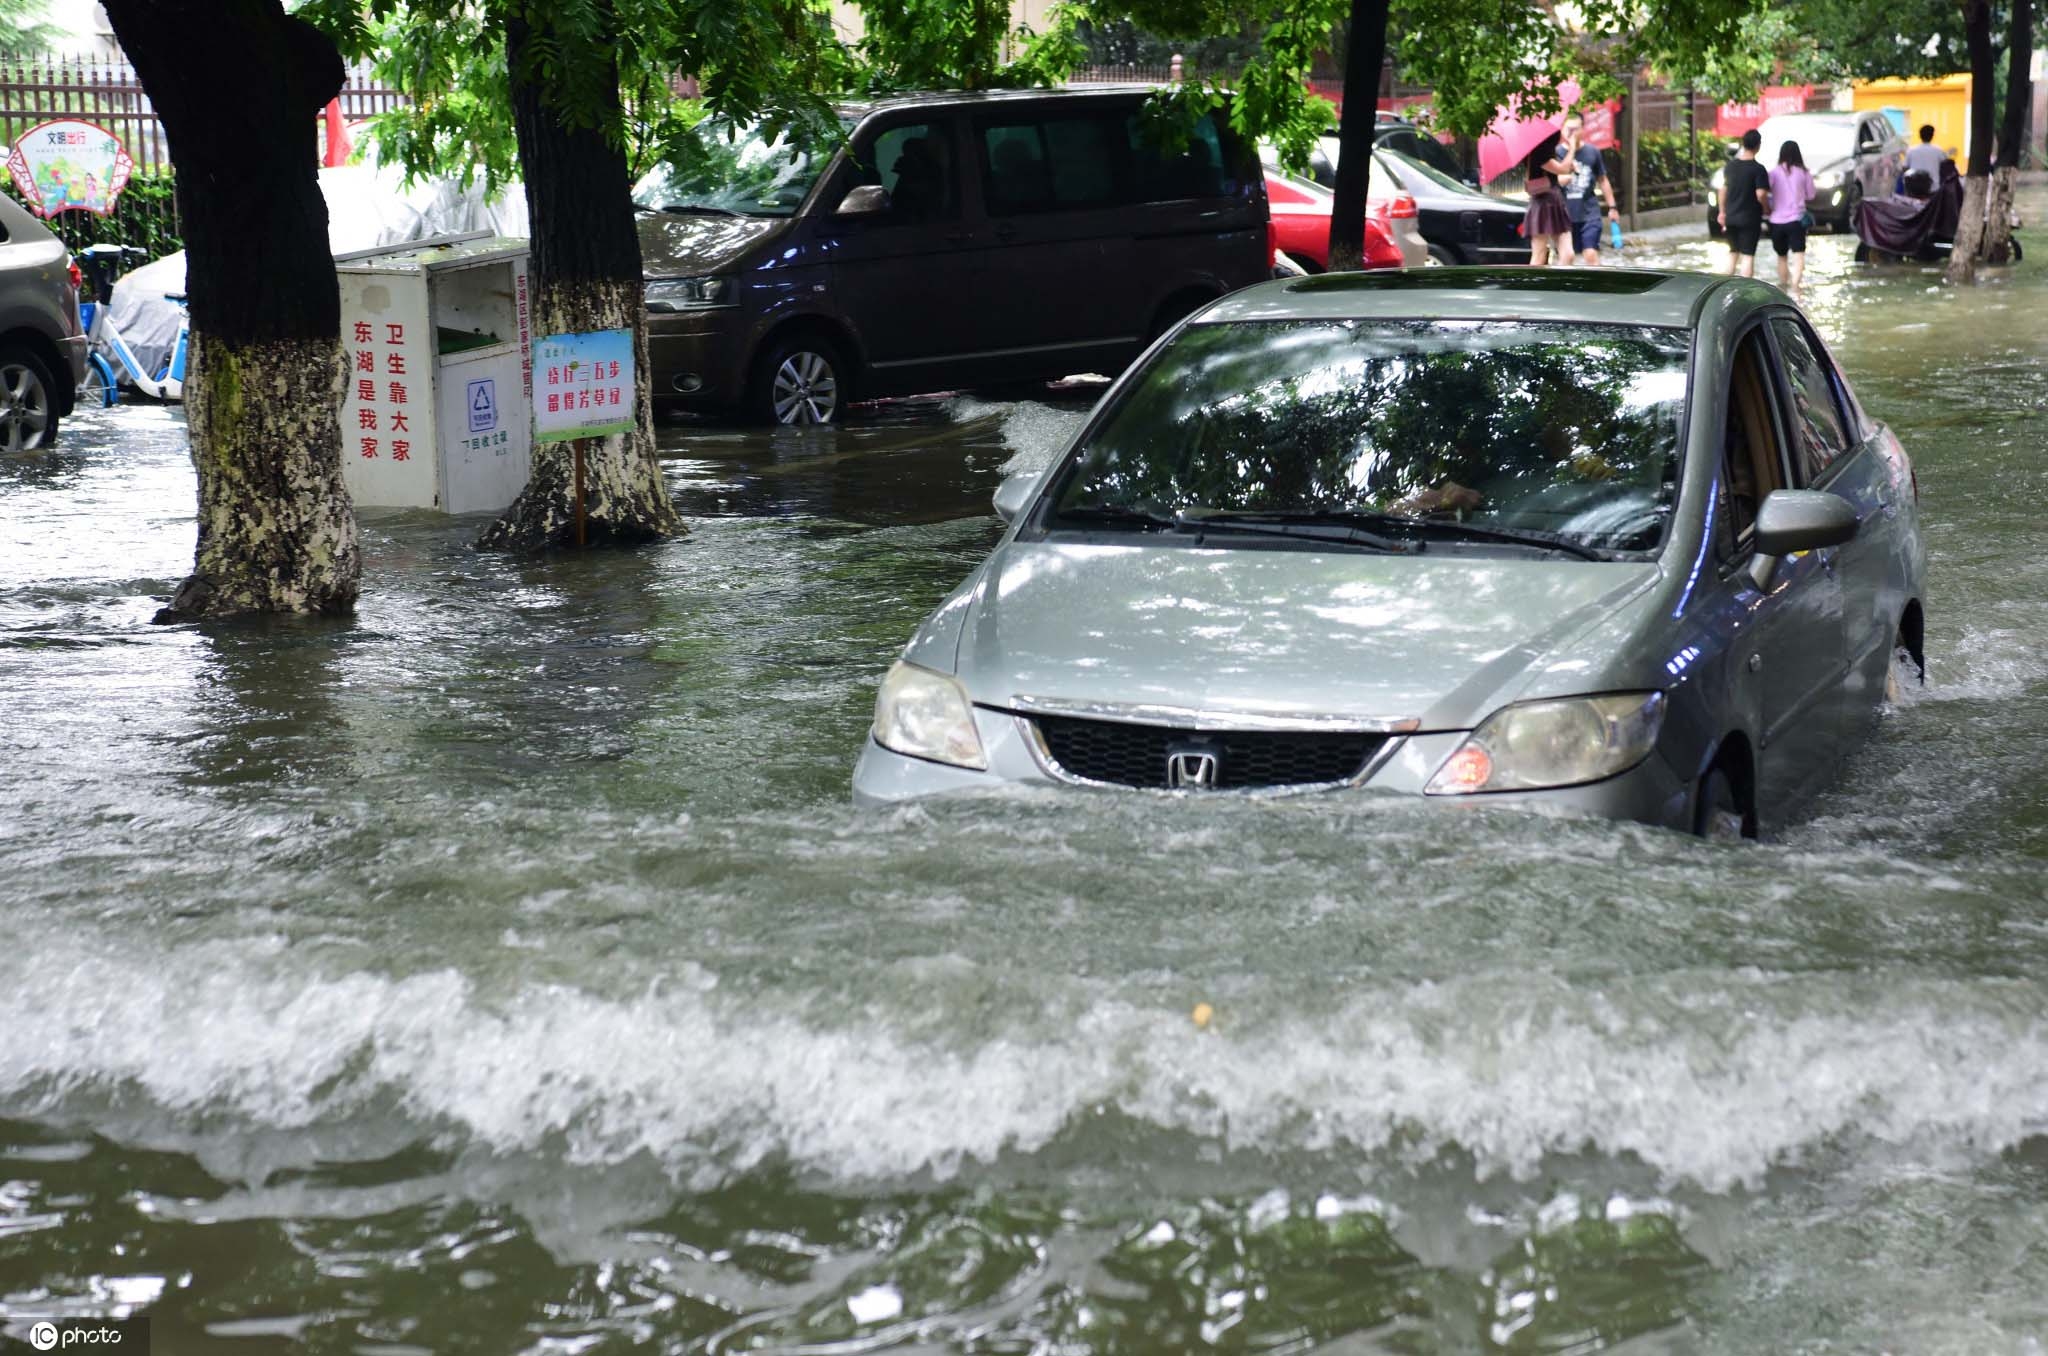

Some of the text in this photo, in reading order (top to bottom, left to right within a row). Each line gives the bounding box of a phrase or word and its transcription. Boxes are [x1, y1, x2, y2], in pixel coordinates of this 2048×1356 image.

[48, 131, 86, 145] 文明出行
[548, 361, 621, 384] 绕行三五步
[354, 321, 378, 458] 东湖是我家
[386, 324, 410, 461] 卫生靠大家
[548, 387, 621, 412] 留得芳草绿
